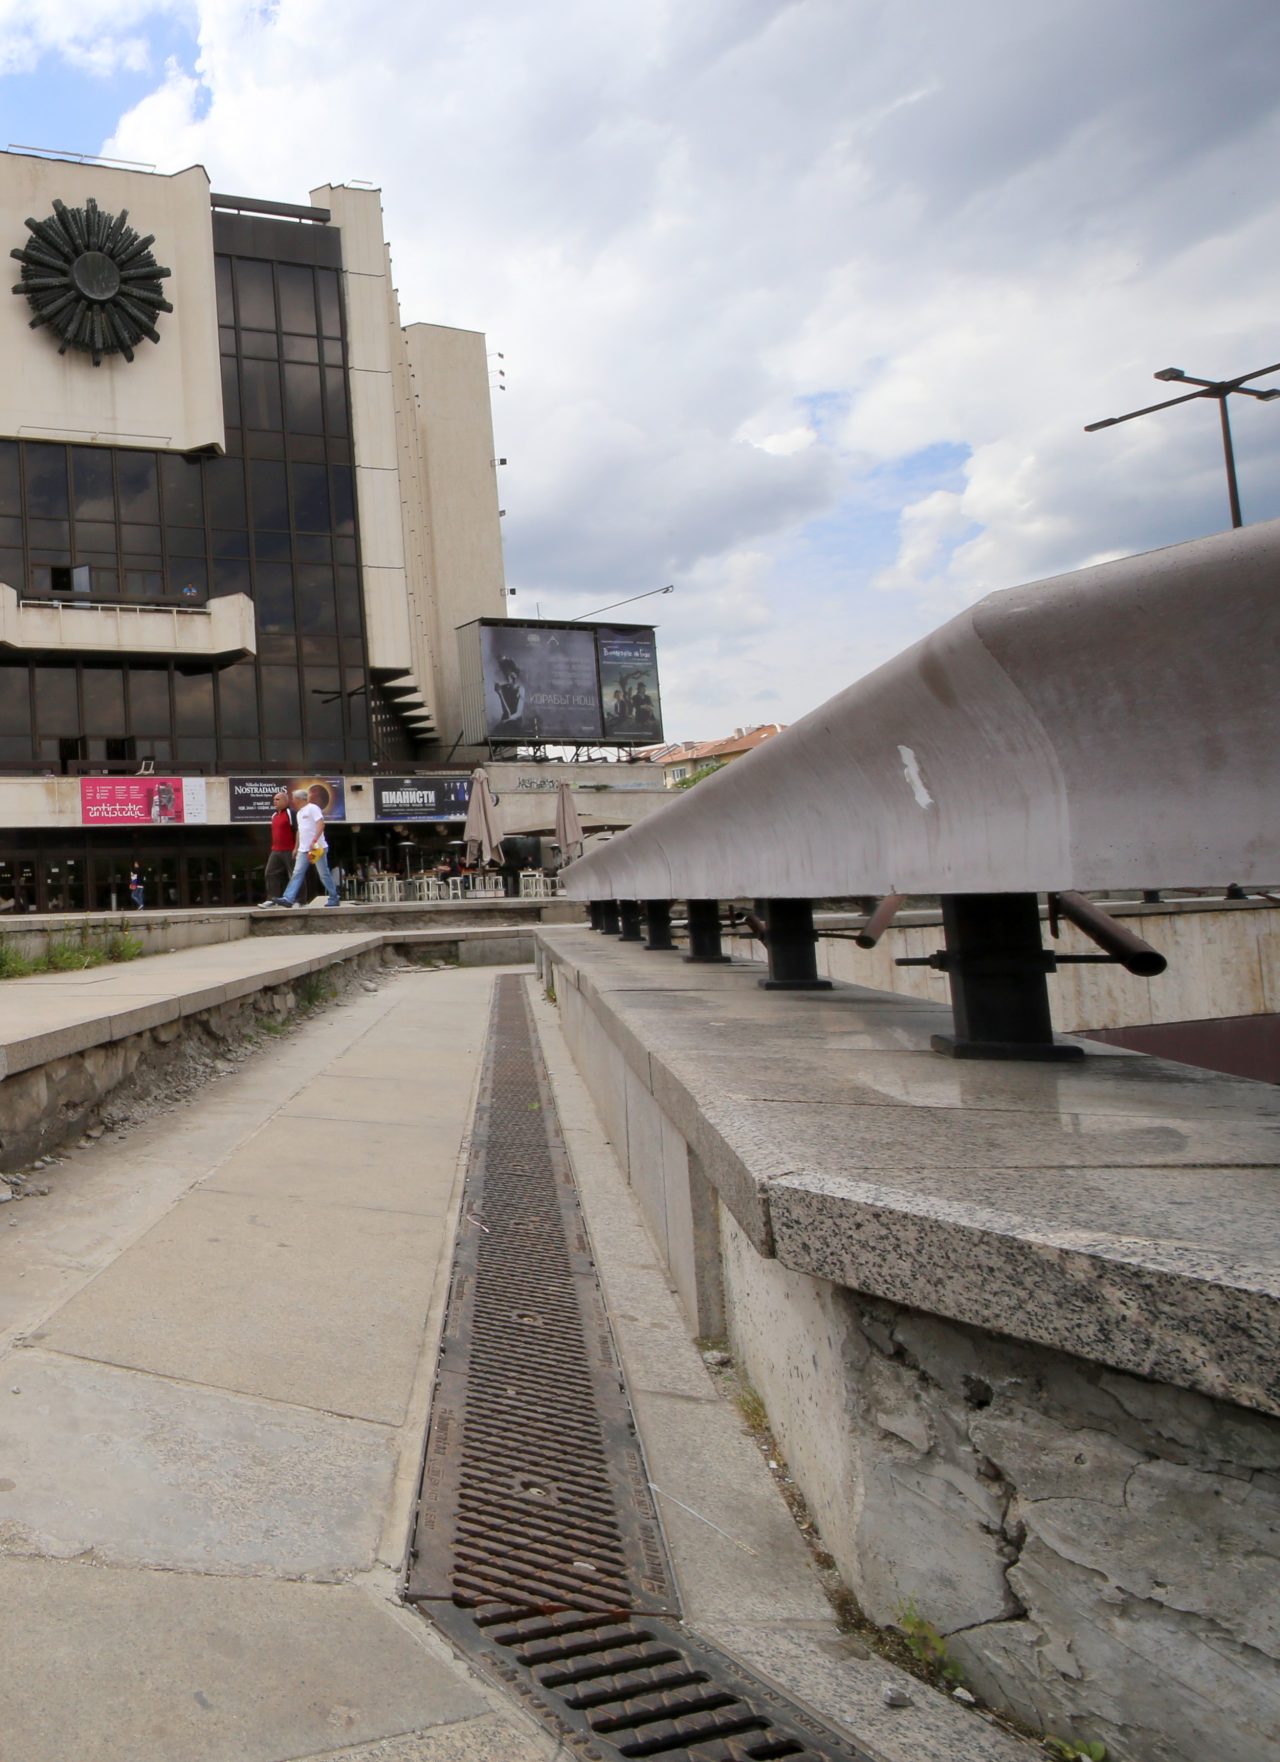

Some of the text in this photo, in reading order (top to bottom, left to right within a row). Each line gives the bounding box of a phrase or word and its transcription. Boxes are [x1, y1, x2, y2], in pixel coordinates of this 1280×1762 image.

[234, 785, 288, 795] NOSTRADAMUS
[381, 790, 436, 804] ПИАНИСТИ
[86, 802, 145, 818] antistatic
